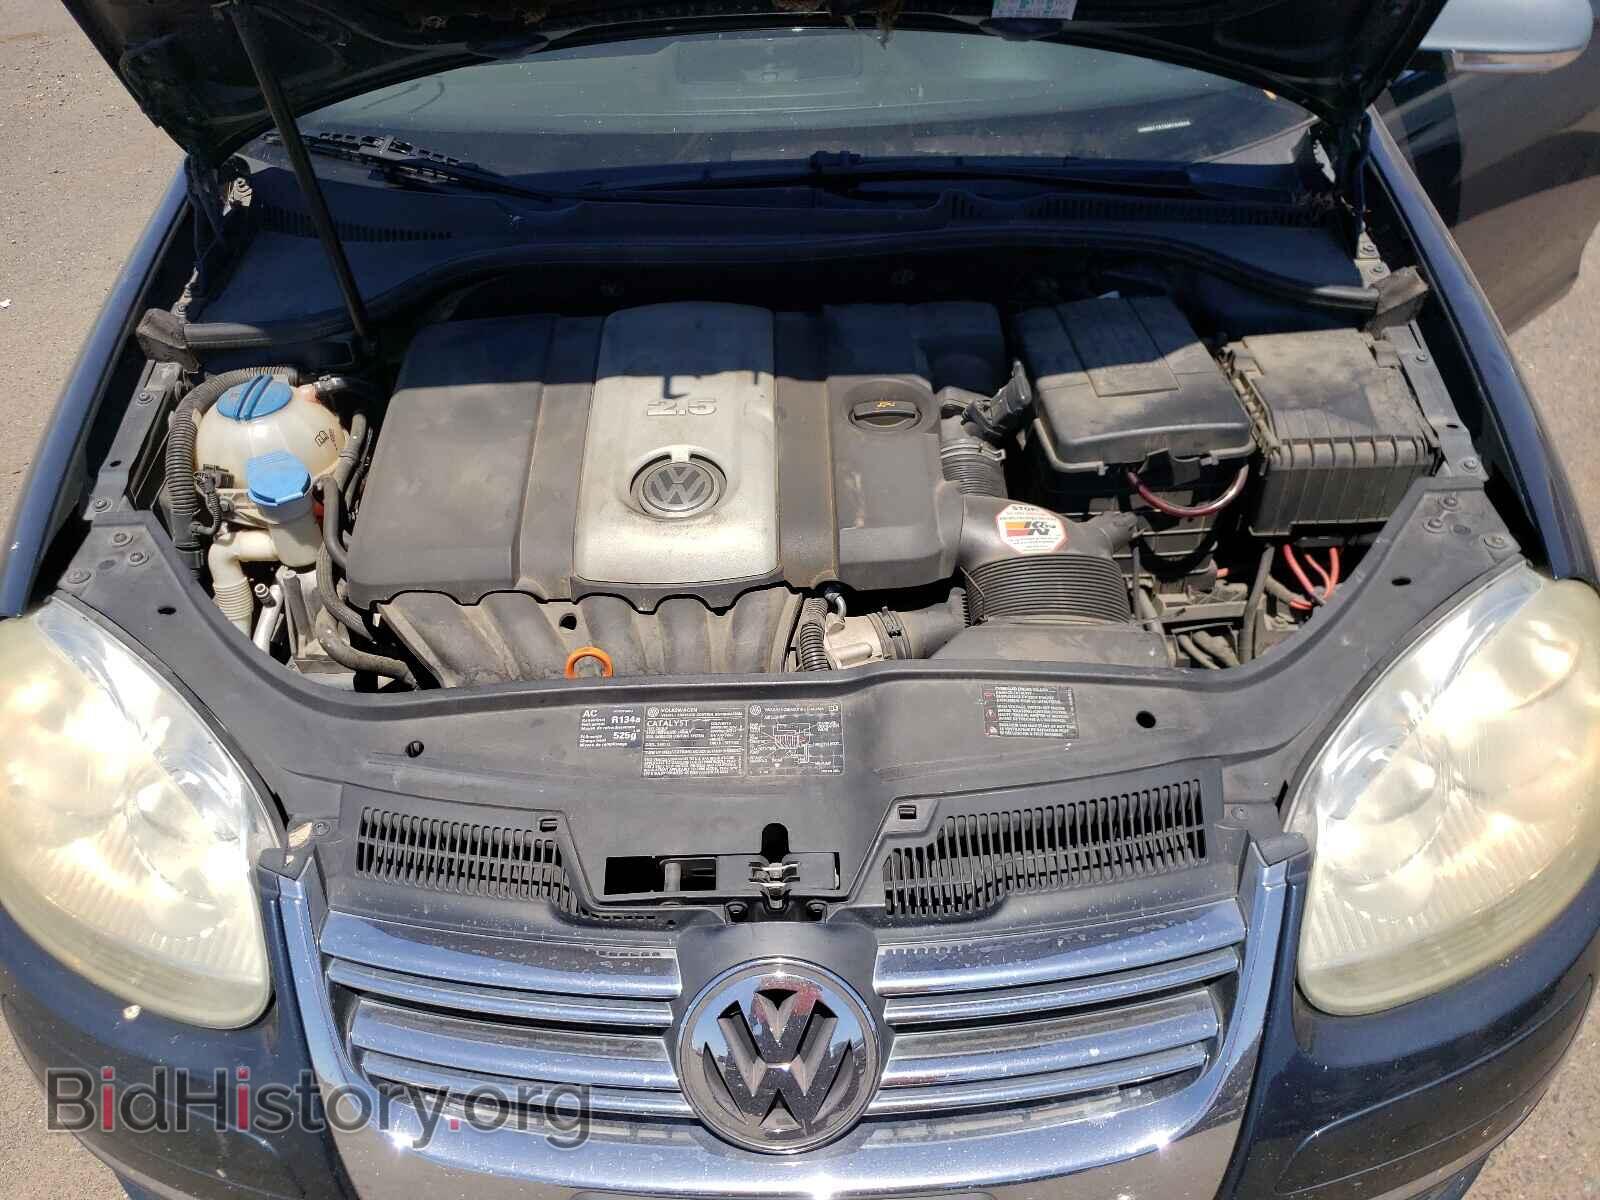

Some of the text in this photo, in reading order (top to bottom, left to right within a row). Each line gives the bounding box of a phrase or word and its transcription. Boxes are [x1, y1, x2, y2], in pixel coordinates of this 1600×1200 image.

[647, 400, 717, 416] 2.5
[643, 462, 714, 512] VW
[582, 709, 598, 718] AC
[611, 715, 641, 724] R134a
[646, 719, 689, 728] CATALYST
[613, 731, 637, 741] 525g
[688, 968, 871, 1143] VW
